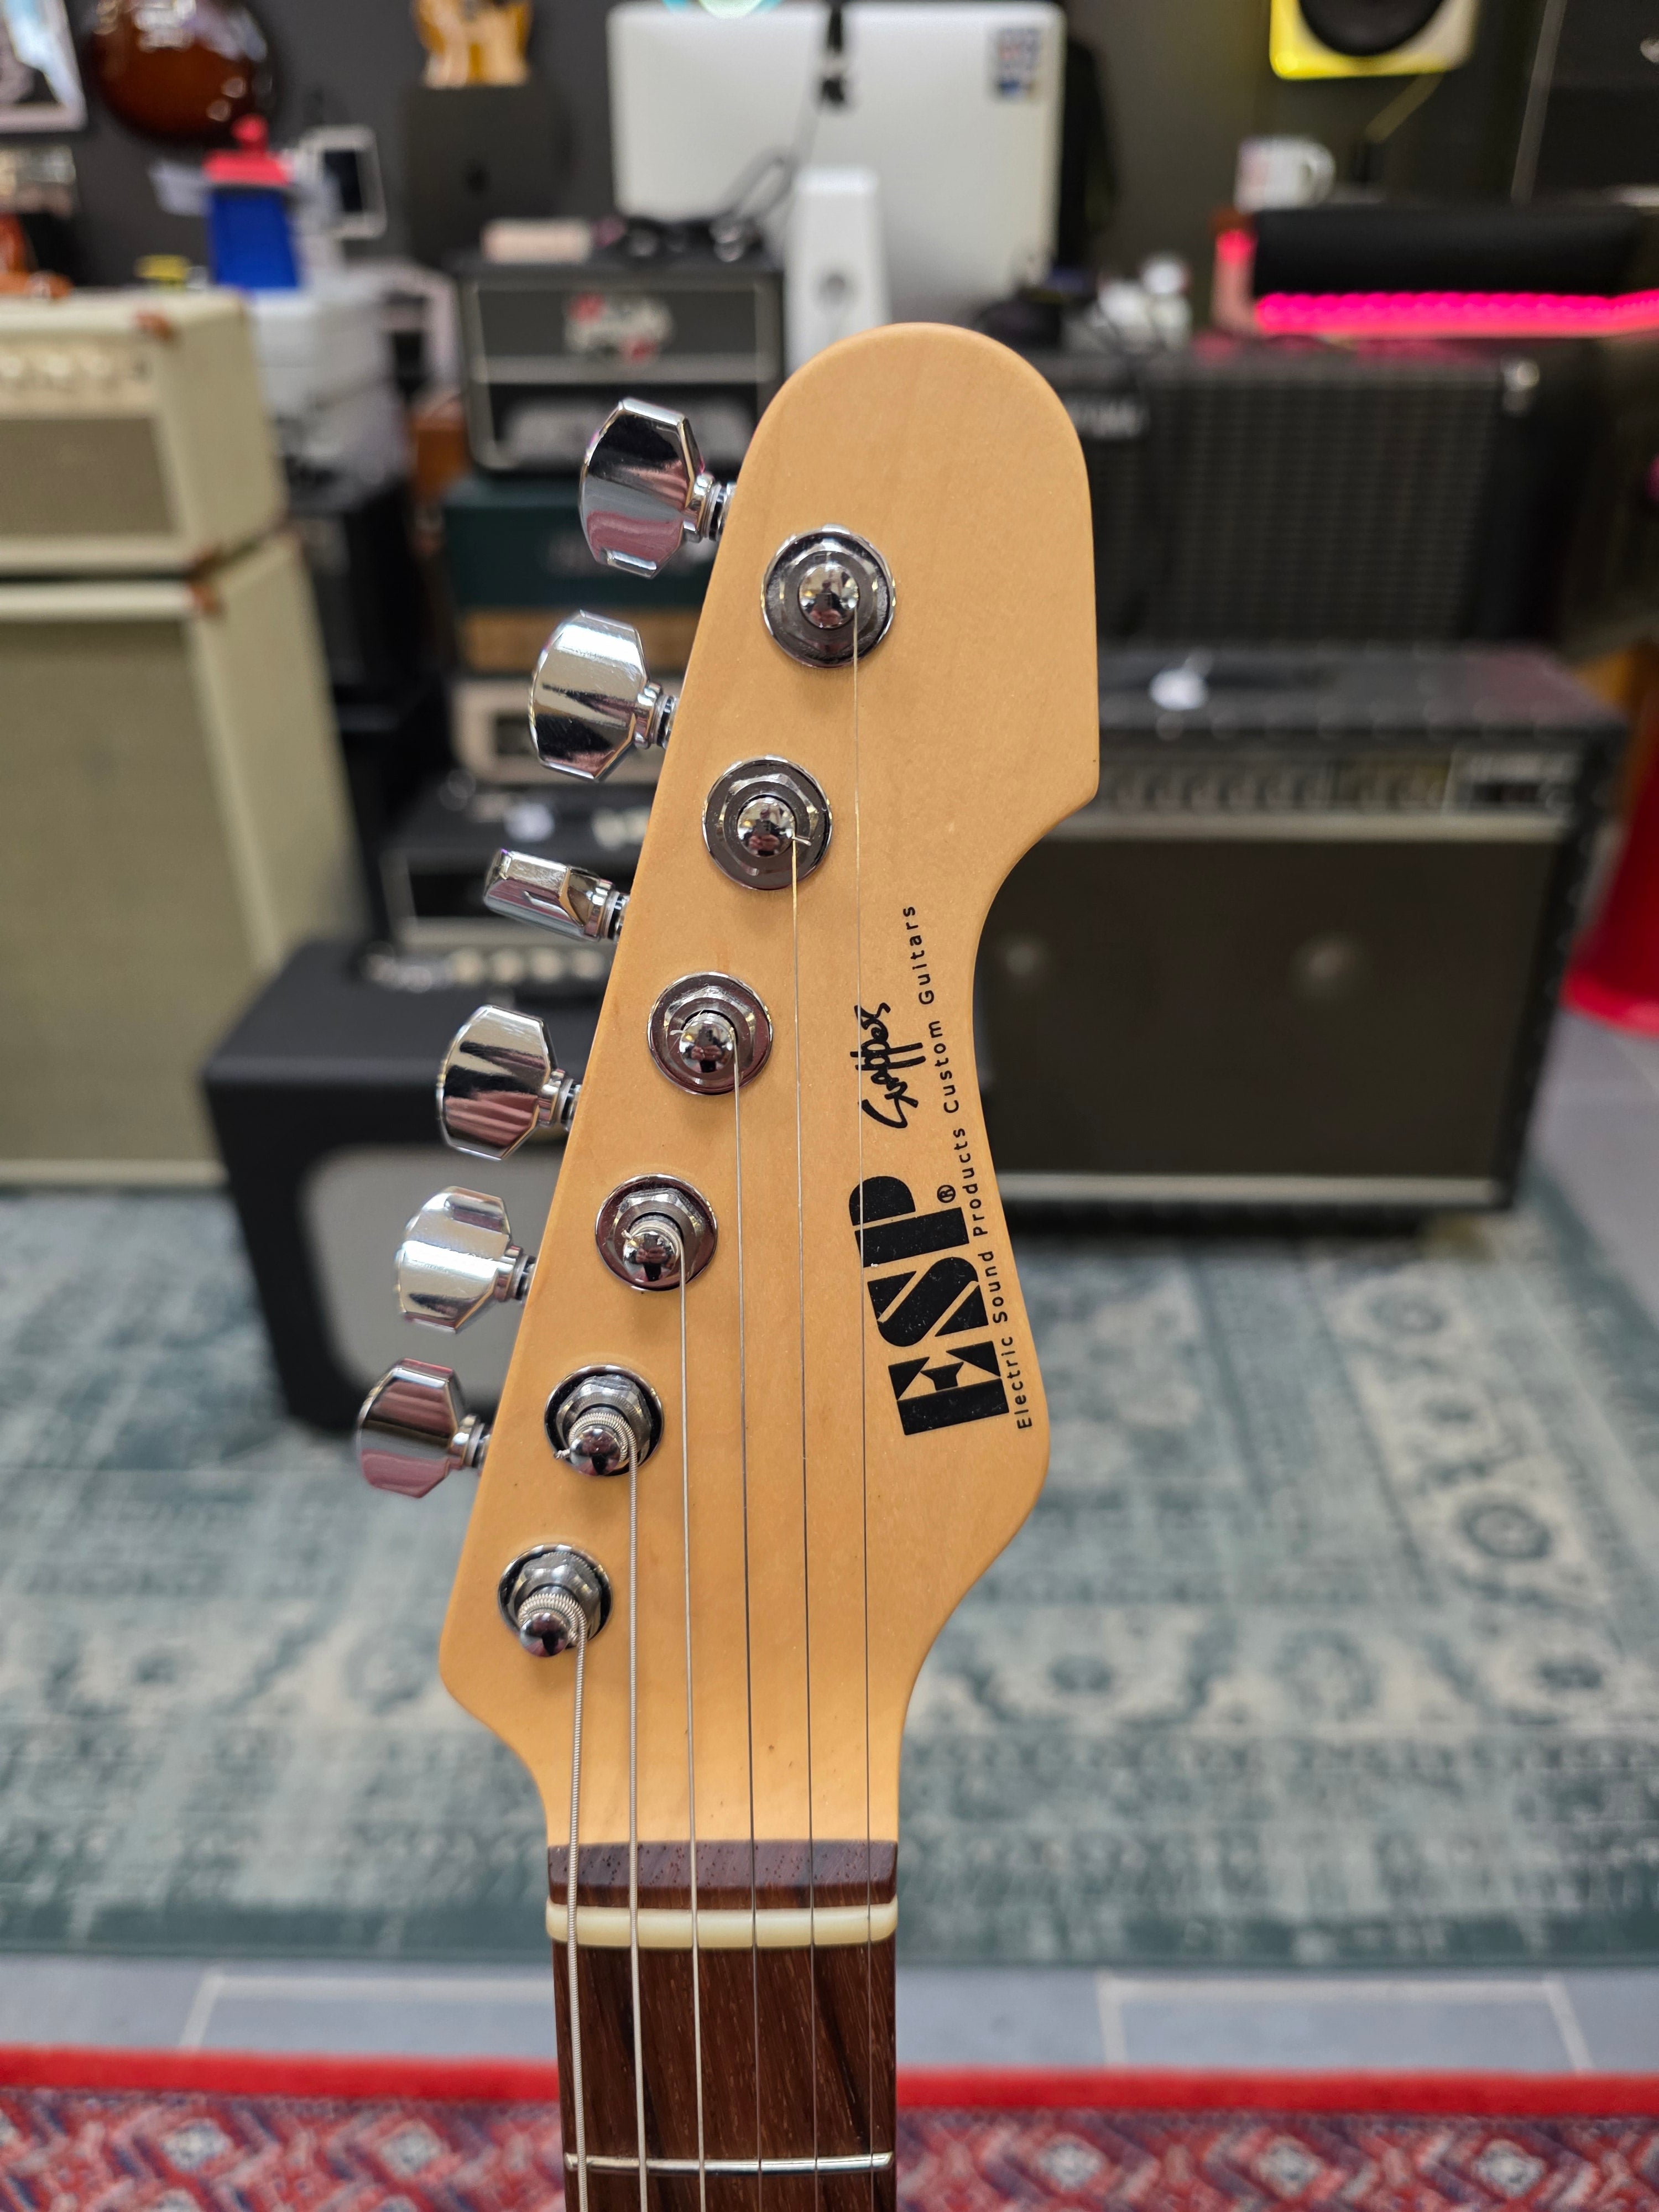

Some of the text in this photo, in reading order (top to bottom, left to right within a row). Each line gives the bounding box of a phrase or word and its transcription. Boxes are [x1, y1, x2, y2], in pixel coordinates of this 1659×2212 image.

[848, 1176, 1010, 1437] ESP
[902, 906, 1033, 1430] Electric Sound Products Custom Guitars
